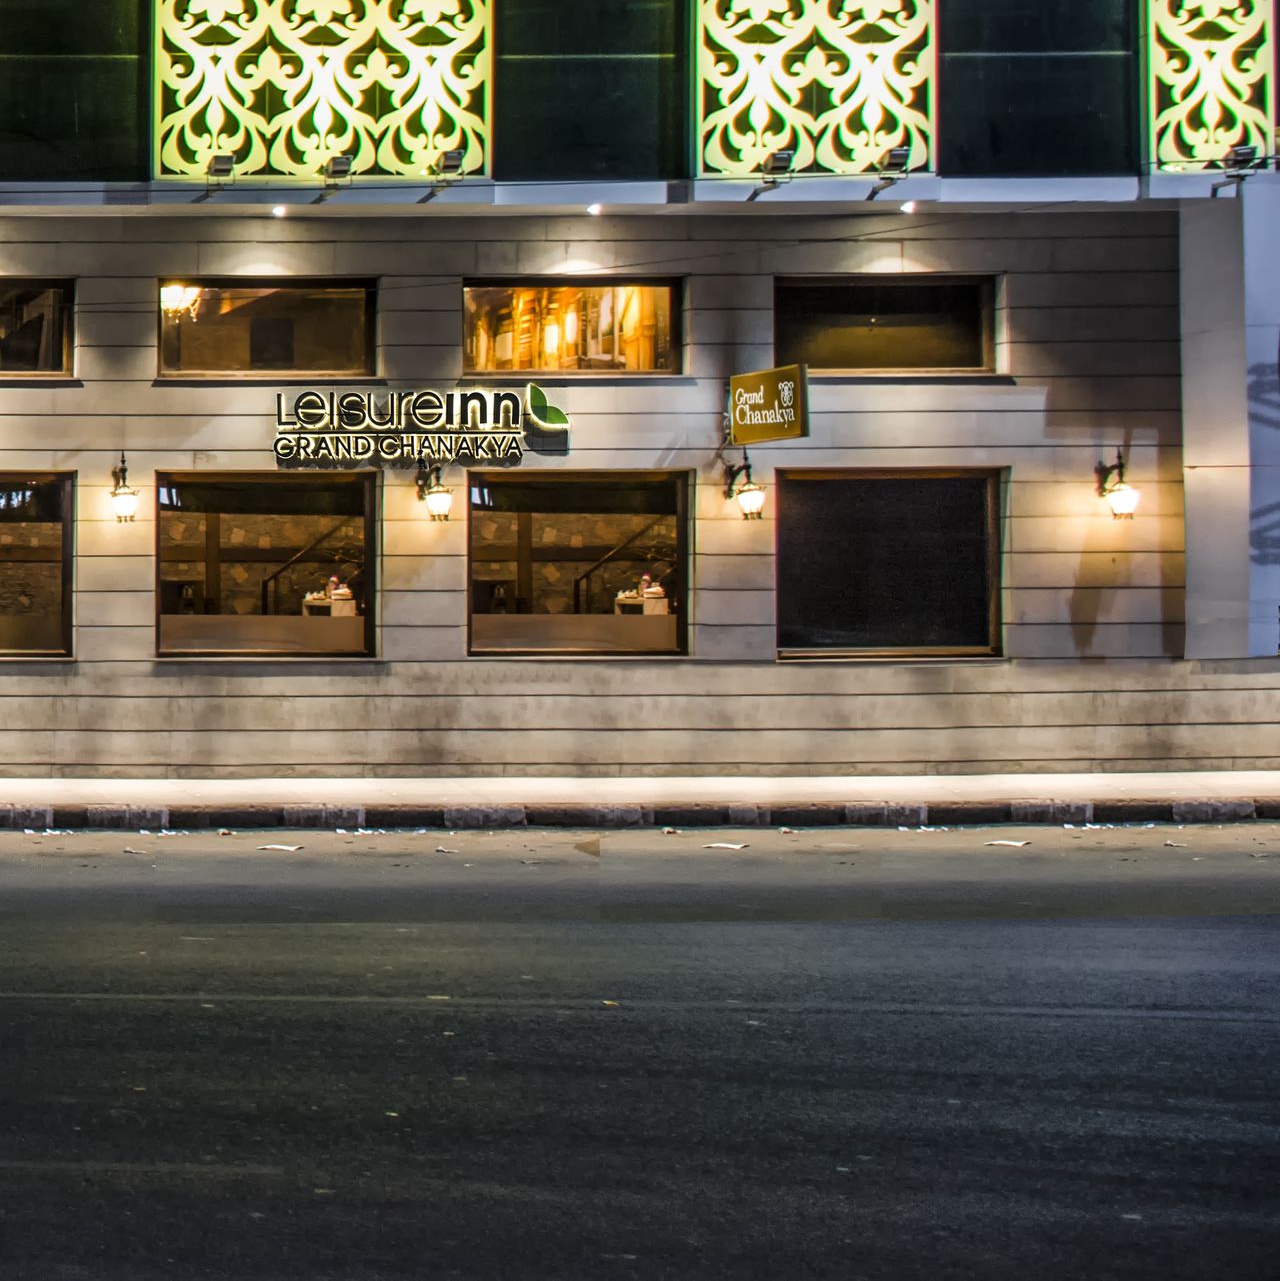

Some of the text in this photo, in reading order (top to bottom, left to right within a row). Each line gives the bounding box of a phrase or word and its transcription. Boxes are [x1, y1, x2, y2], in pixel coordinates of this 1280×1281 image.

[736, 385, 764, 405] Grand
[736, 400, 795, 428] Chanakya
[274, 435, 523, 460] GRAND CHANAKYA
